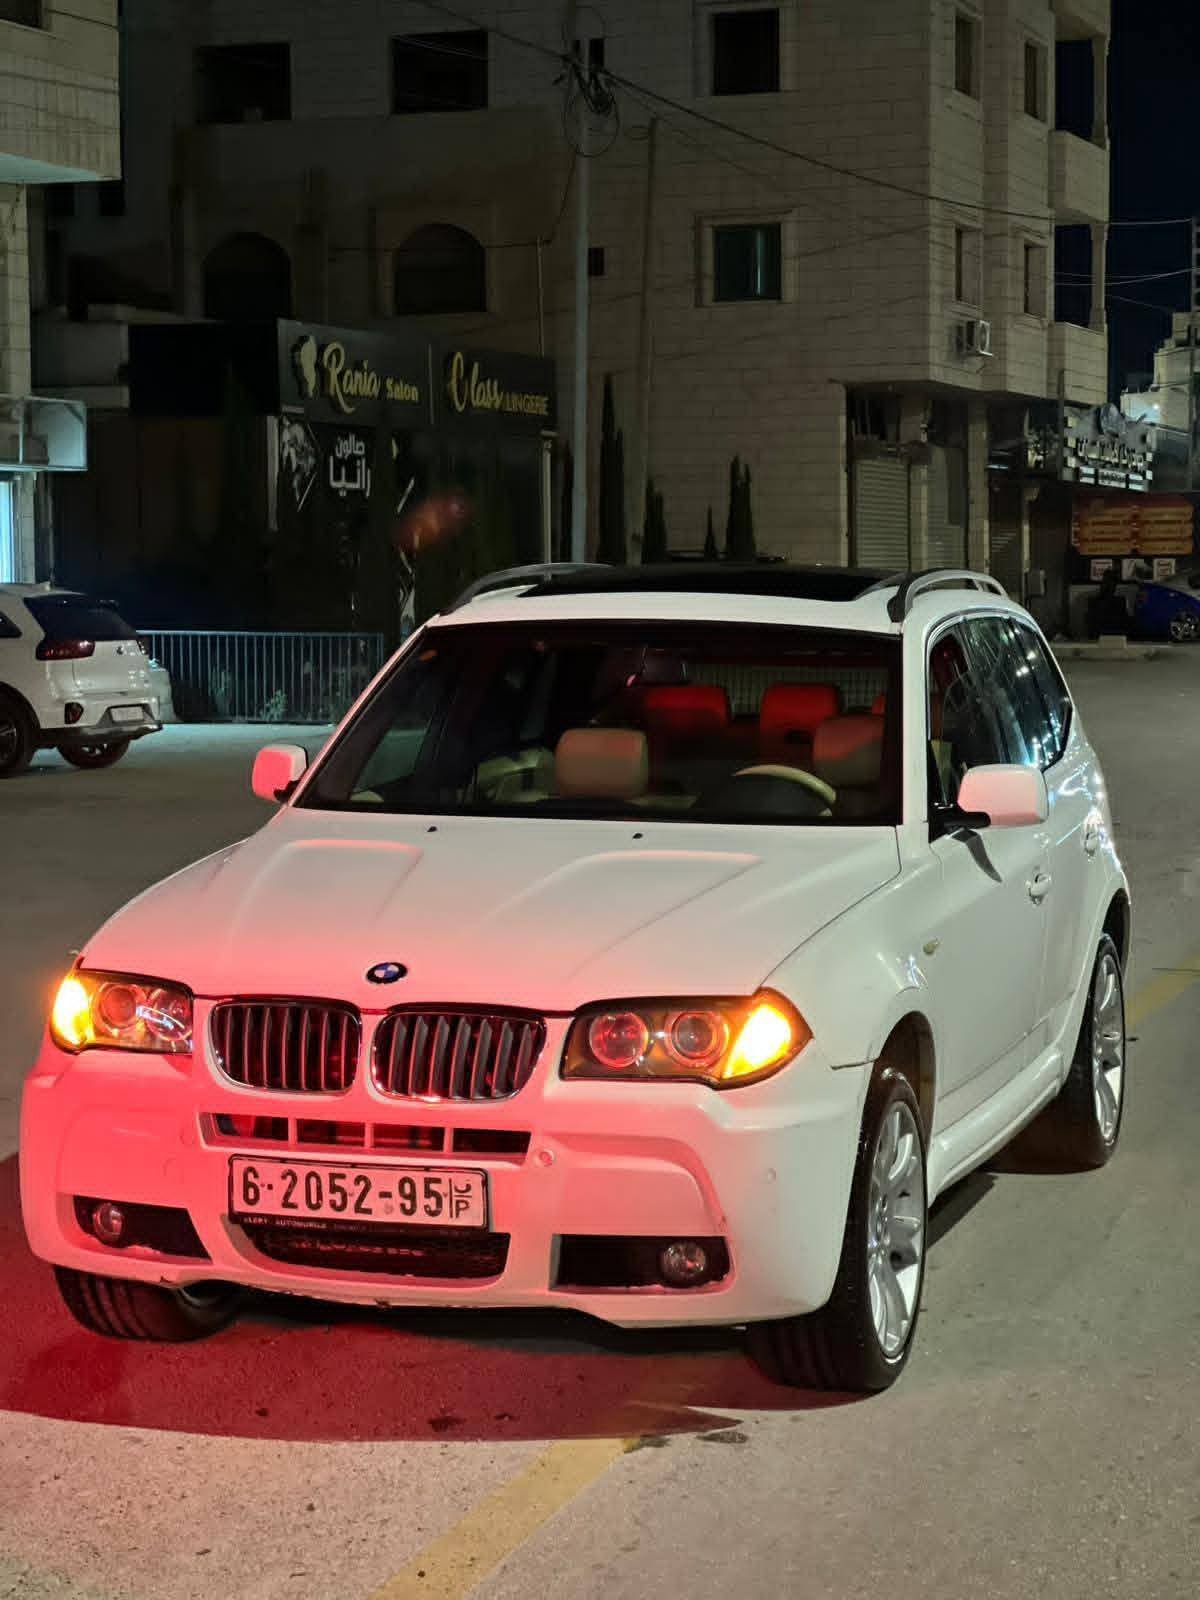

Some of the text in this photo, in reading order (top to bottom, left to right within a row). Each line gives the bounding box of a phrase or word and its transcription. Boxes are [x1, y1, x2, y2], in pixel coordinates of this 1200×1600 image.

[323, 342, 419, 413] Rania Salon
[450, 352, 503, 413] Class
[335, 432, 366, 459] صالون
[329, 456, 371, 498] رانيا
[454, 1199, 470, 1218] P
